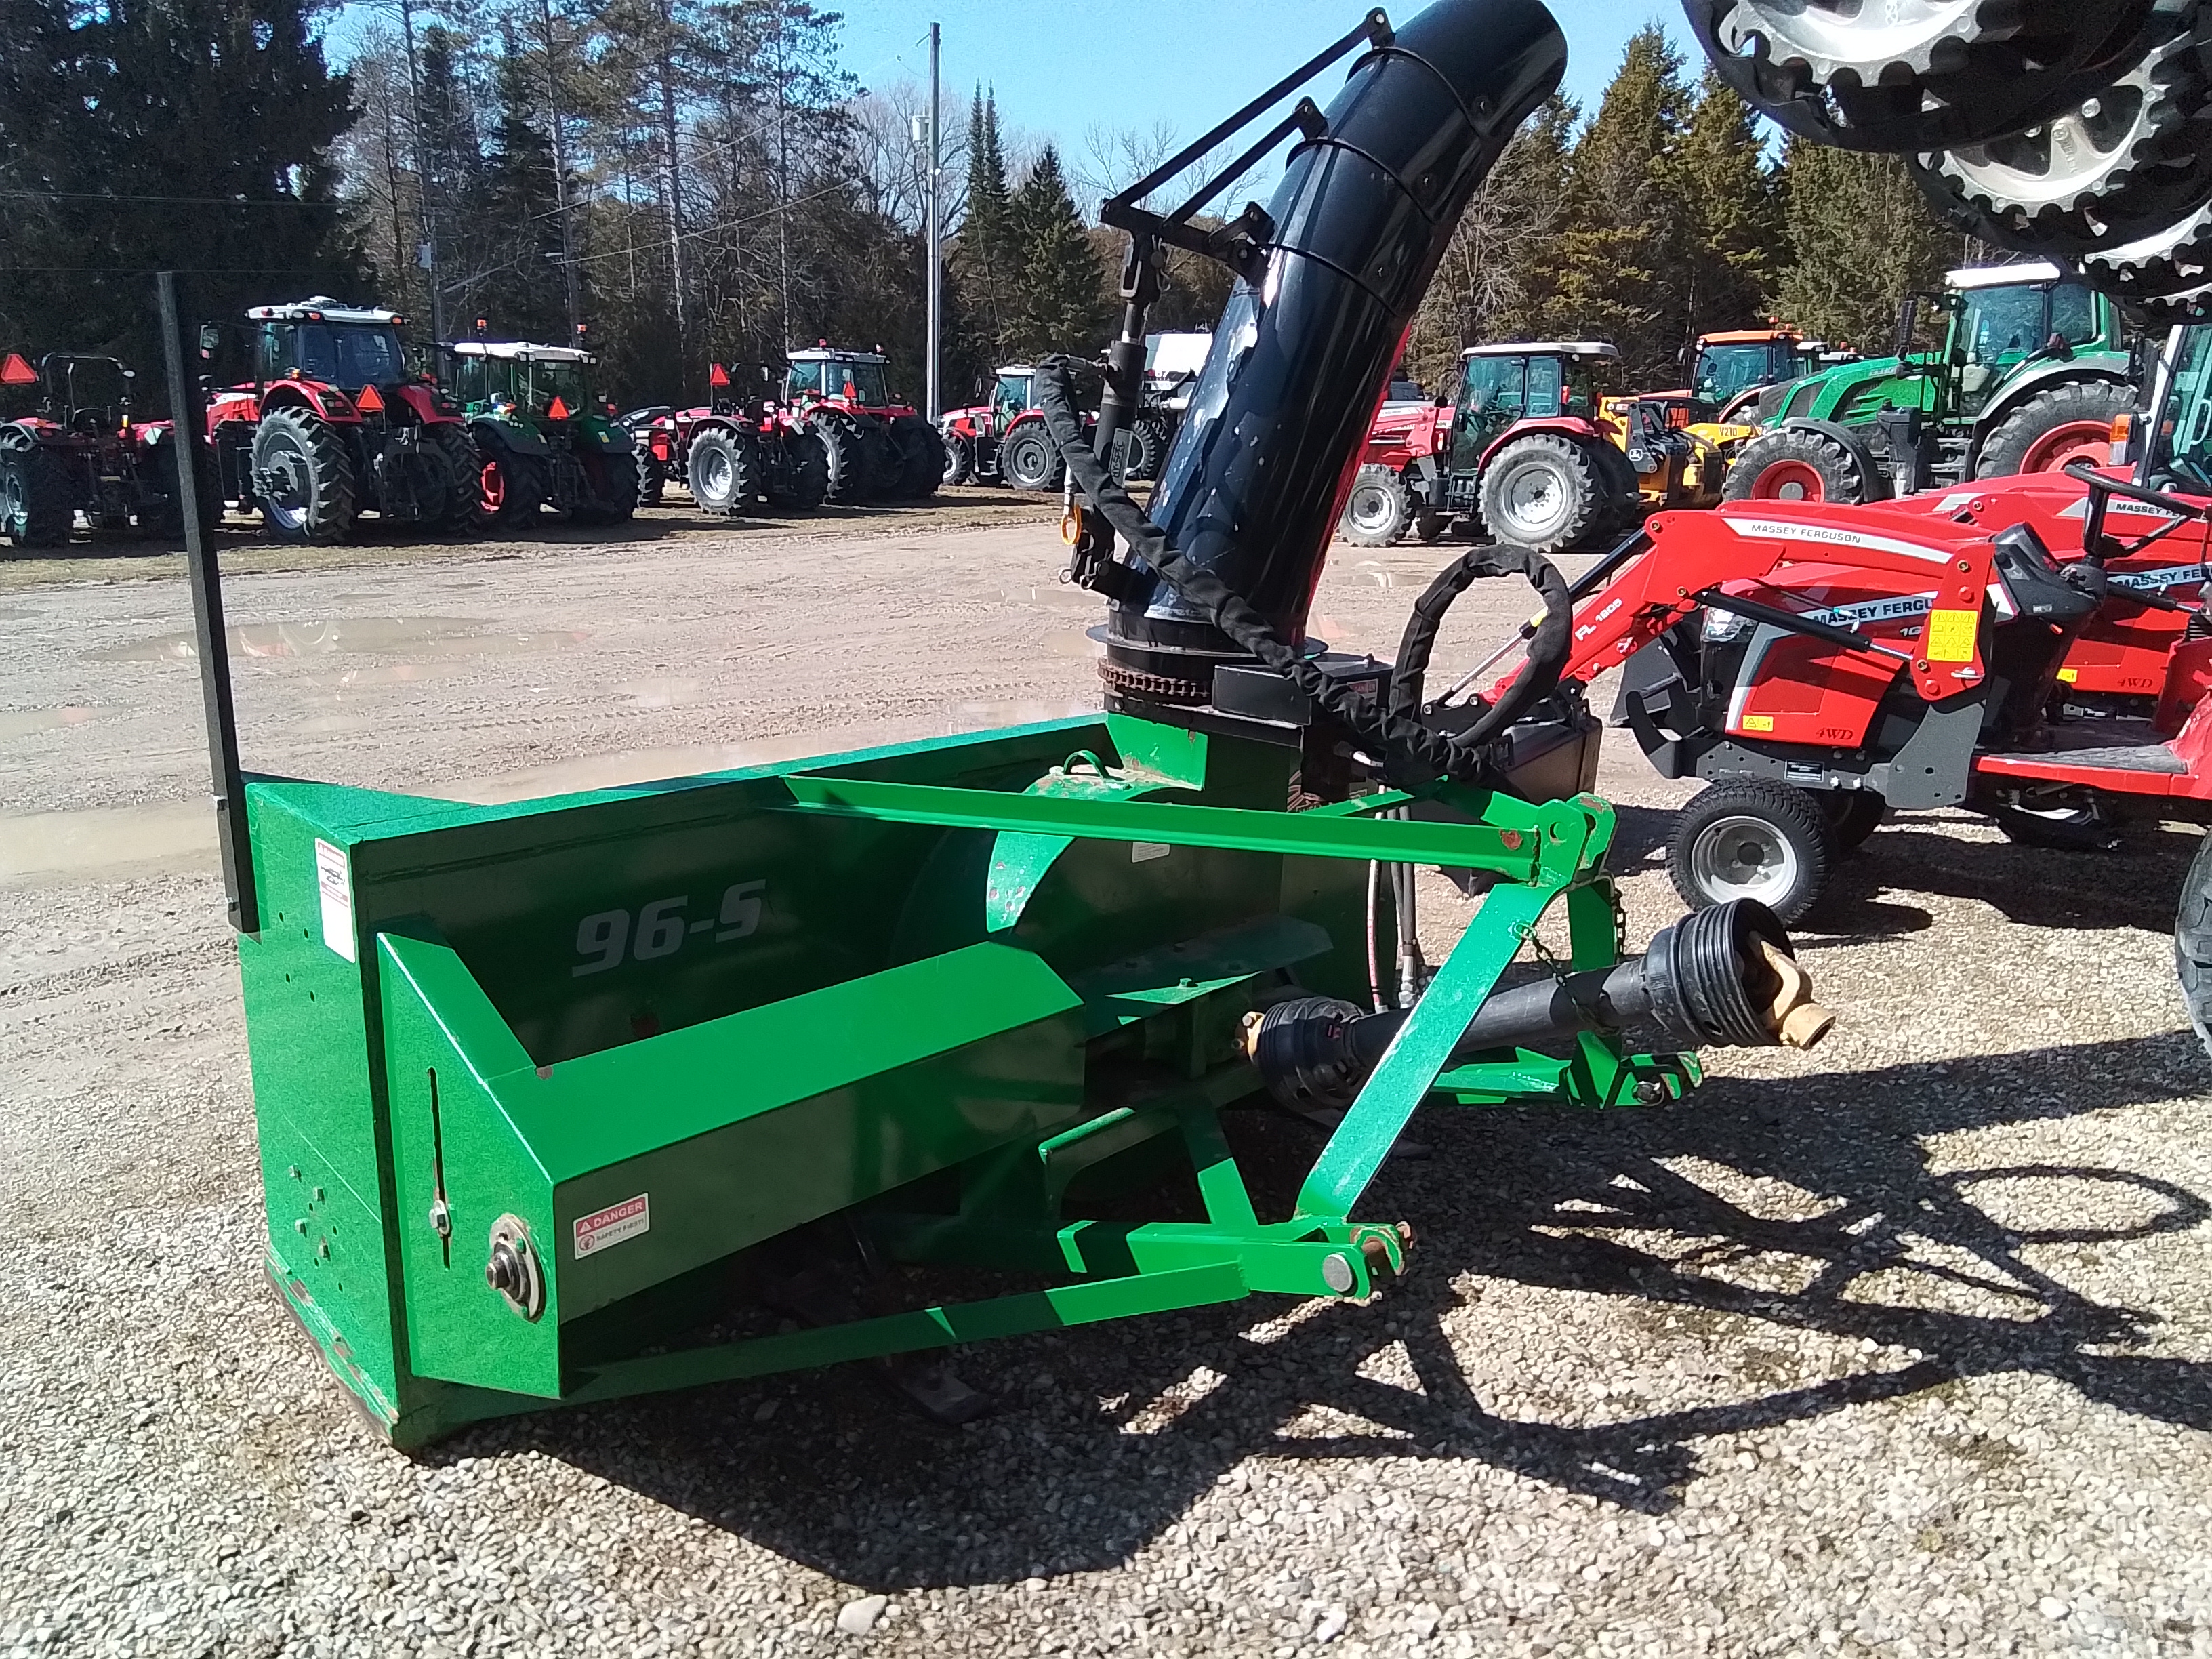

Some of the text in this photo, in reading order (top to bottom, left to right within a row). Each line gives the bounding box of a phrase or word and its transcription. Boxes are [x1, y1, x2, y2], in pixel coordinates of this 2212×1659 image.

[1719, 426, 1738, 437] V210
[2116, 503, 2163, 515] MASSEY
[1751, 525, 1861, 544] MASSEY FERGUSON
[1574, 624, 1597, 641] FL
[2117, 678, 2153, 688] 4WD
[1816, 728, 1853, 740] 4WD
[572, 878, 766, 977] 96-S
[594, 1201, 643, 1228] DANGER
